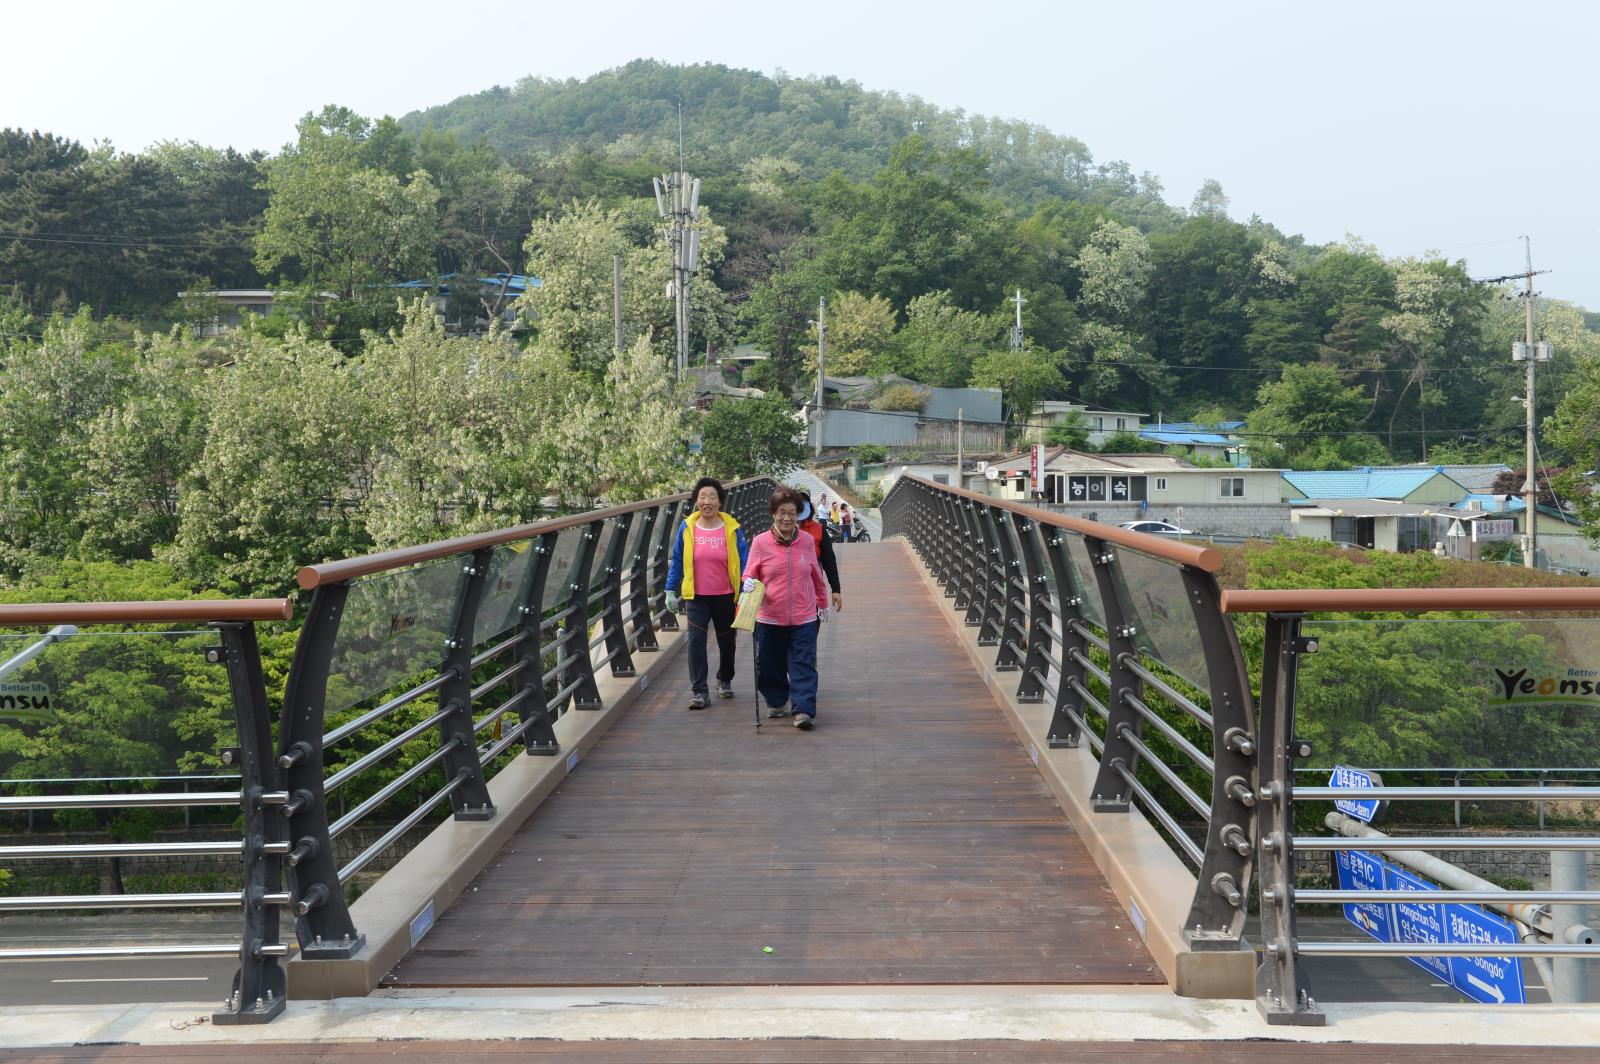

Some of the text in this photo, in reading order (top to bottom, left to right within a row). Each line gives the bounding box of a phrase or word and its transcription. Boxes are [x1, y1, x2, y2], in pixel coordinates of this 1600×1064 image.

[694, 536, 725, 545] ESPRIT
[1567, 668, 1598, 677] Better
[1, 684, 48, 692] Better life
